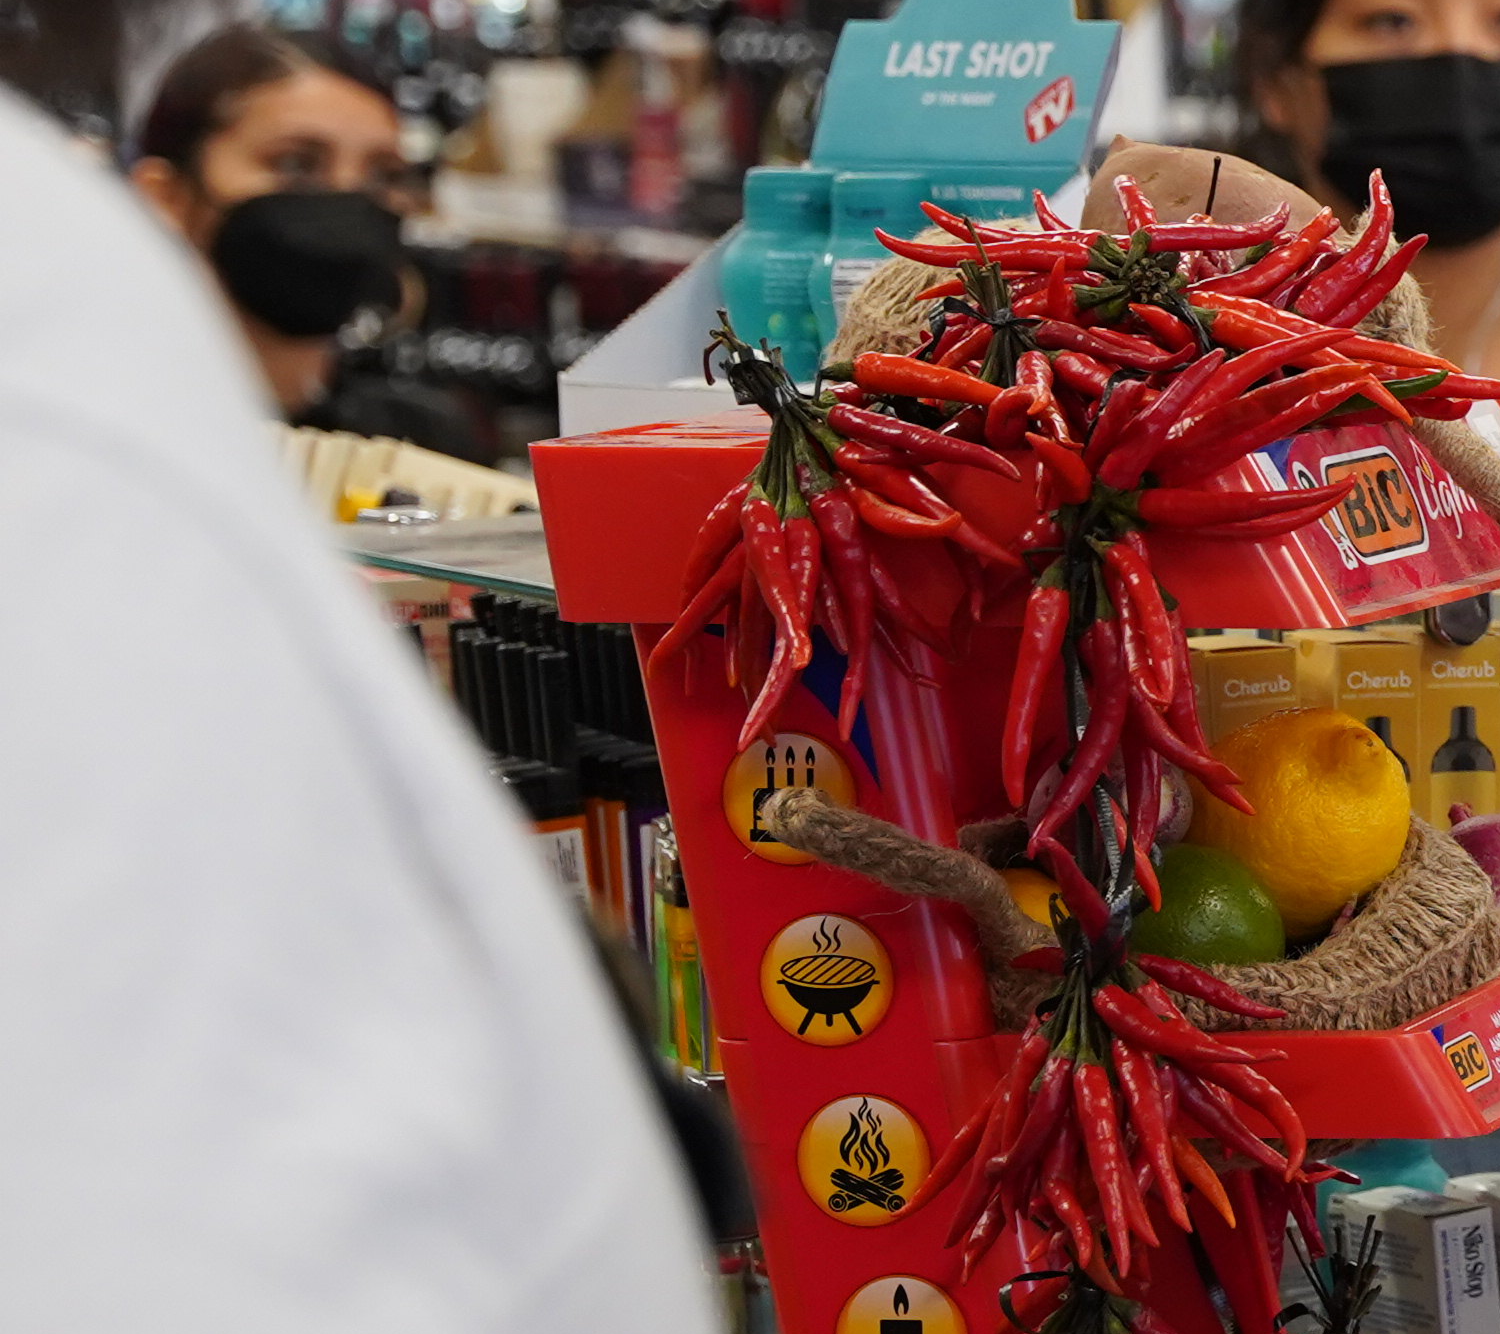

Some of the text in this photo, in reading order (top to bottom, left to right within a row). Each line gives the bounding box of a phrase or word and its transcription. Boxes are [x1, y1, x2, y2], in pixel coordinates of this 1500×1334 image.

[884, 41, 1054, 78] LAST SHOT
[1347, 670, 1411, 691] Cherub
[1431, 659, 1496, 680] Cherub
[1225, 675, 1291, 699] Cherub
